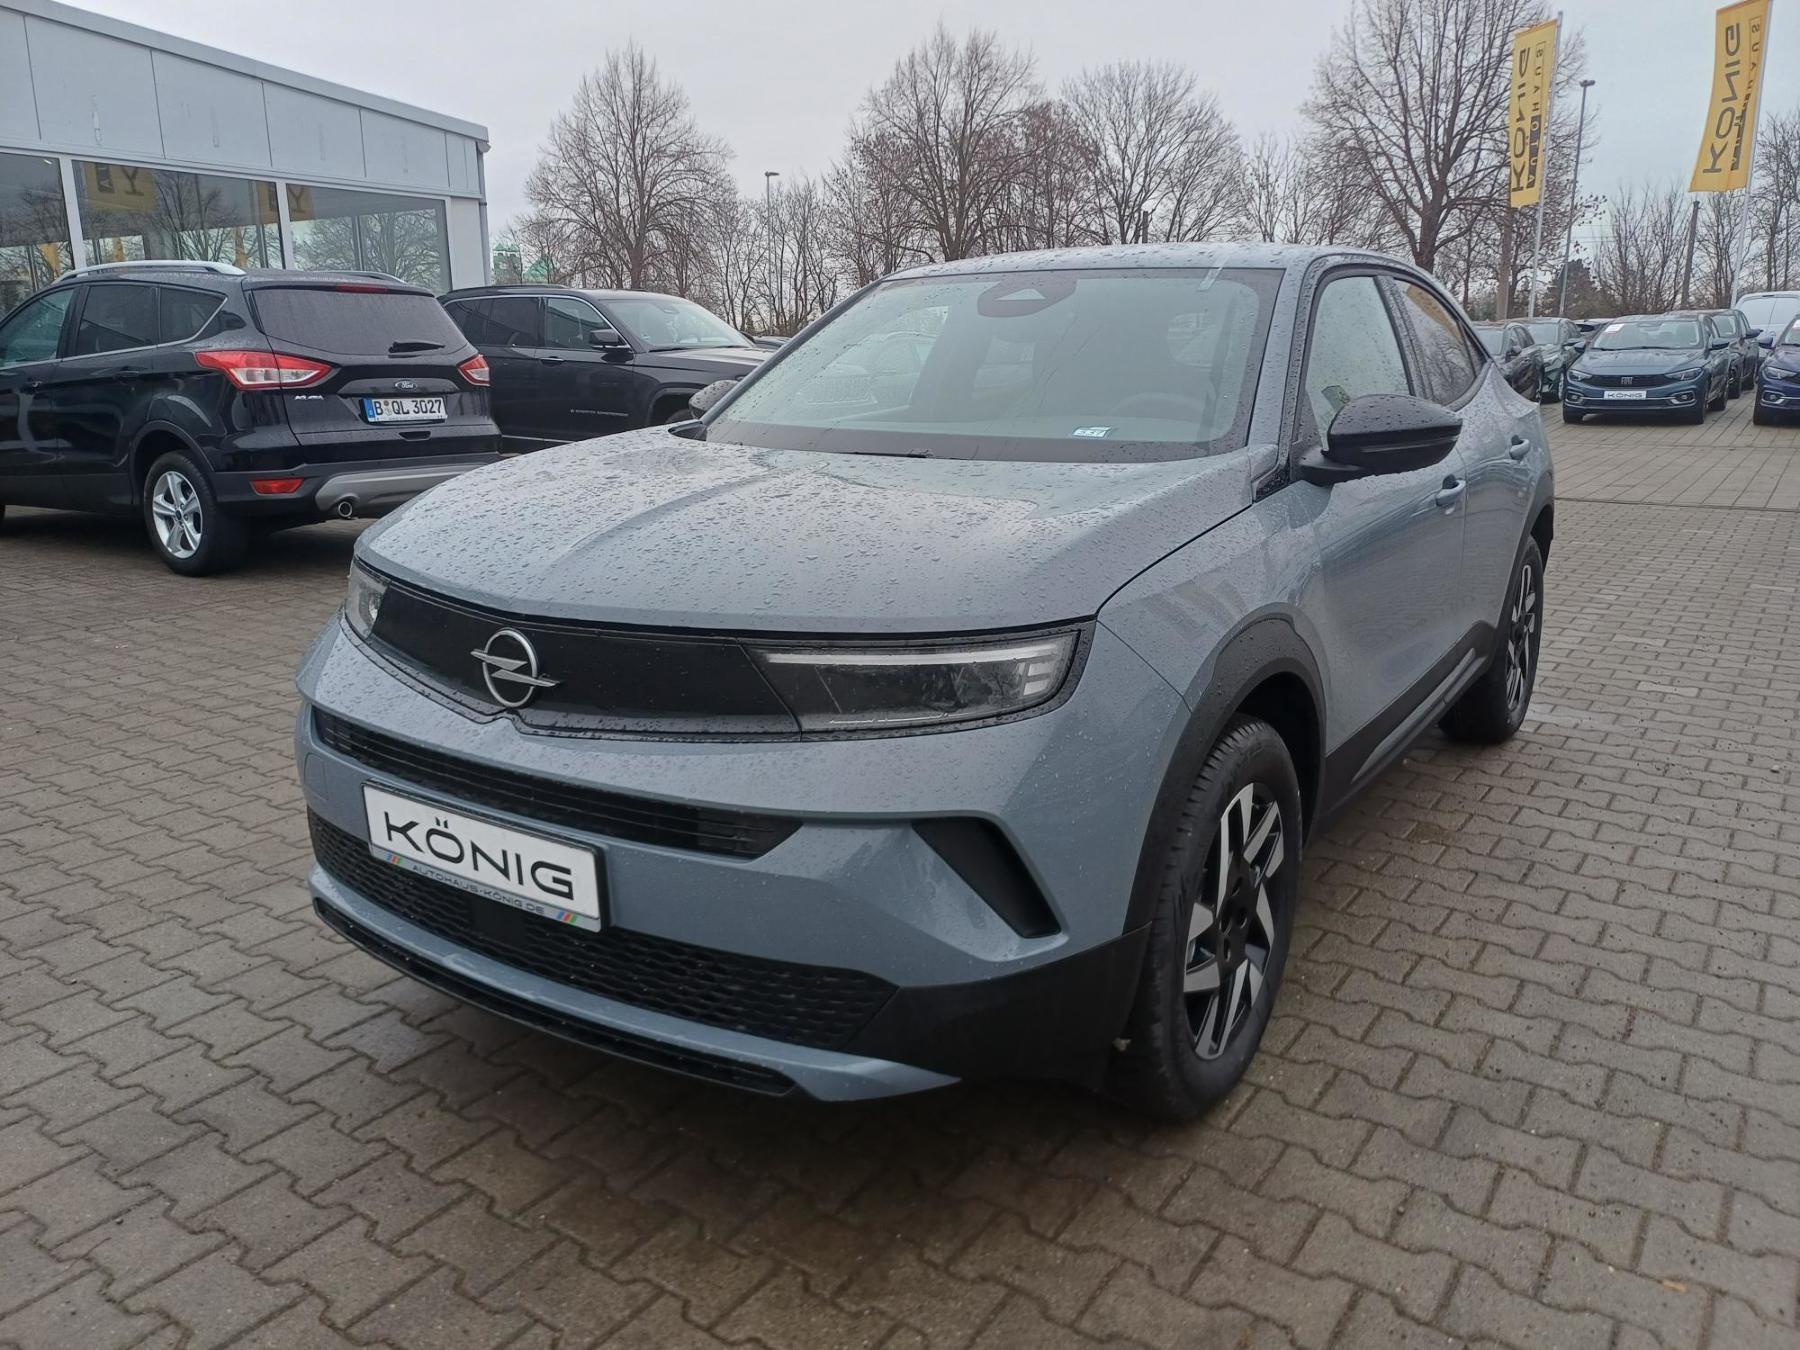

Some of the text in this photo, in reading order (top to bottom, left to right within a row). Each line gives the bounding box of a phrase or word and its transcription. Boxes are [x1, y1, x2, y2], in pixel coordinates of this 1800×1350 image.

[373, 399, 442, 416] B QL 3027
[383, 811, 575, 901] KÖNIG
